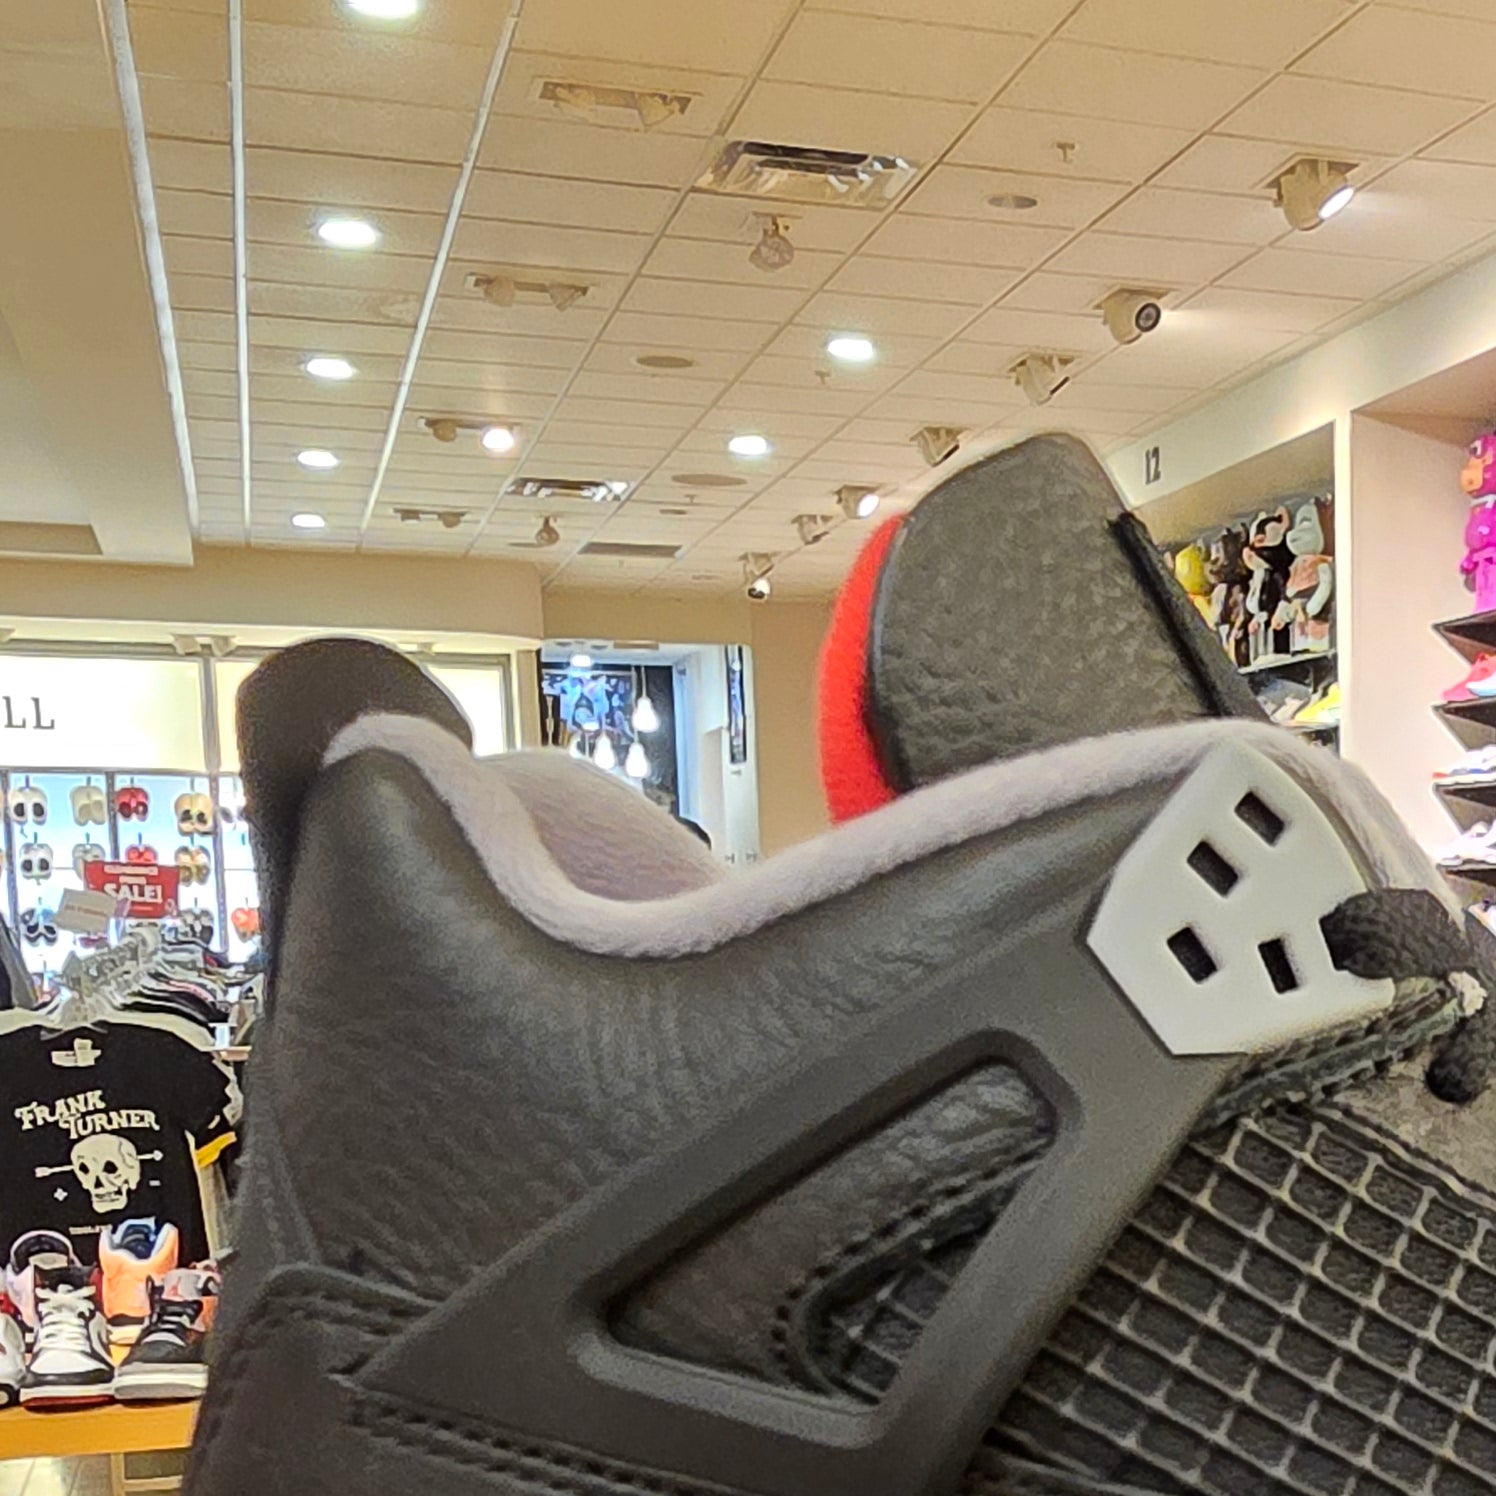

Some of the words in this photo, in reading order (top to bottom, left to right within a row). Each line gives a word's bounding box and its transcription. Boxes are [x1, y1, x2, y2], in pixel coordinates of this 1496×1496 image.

[1145, 446, 1161, 485] 12
[14, 1089, 106, 1131] FRANK
[58, 1109, 160, 1139] TURNER
